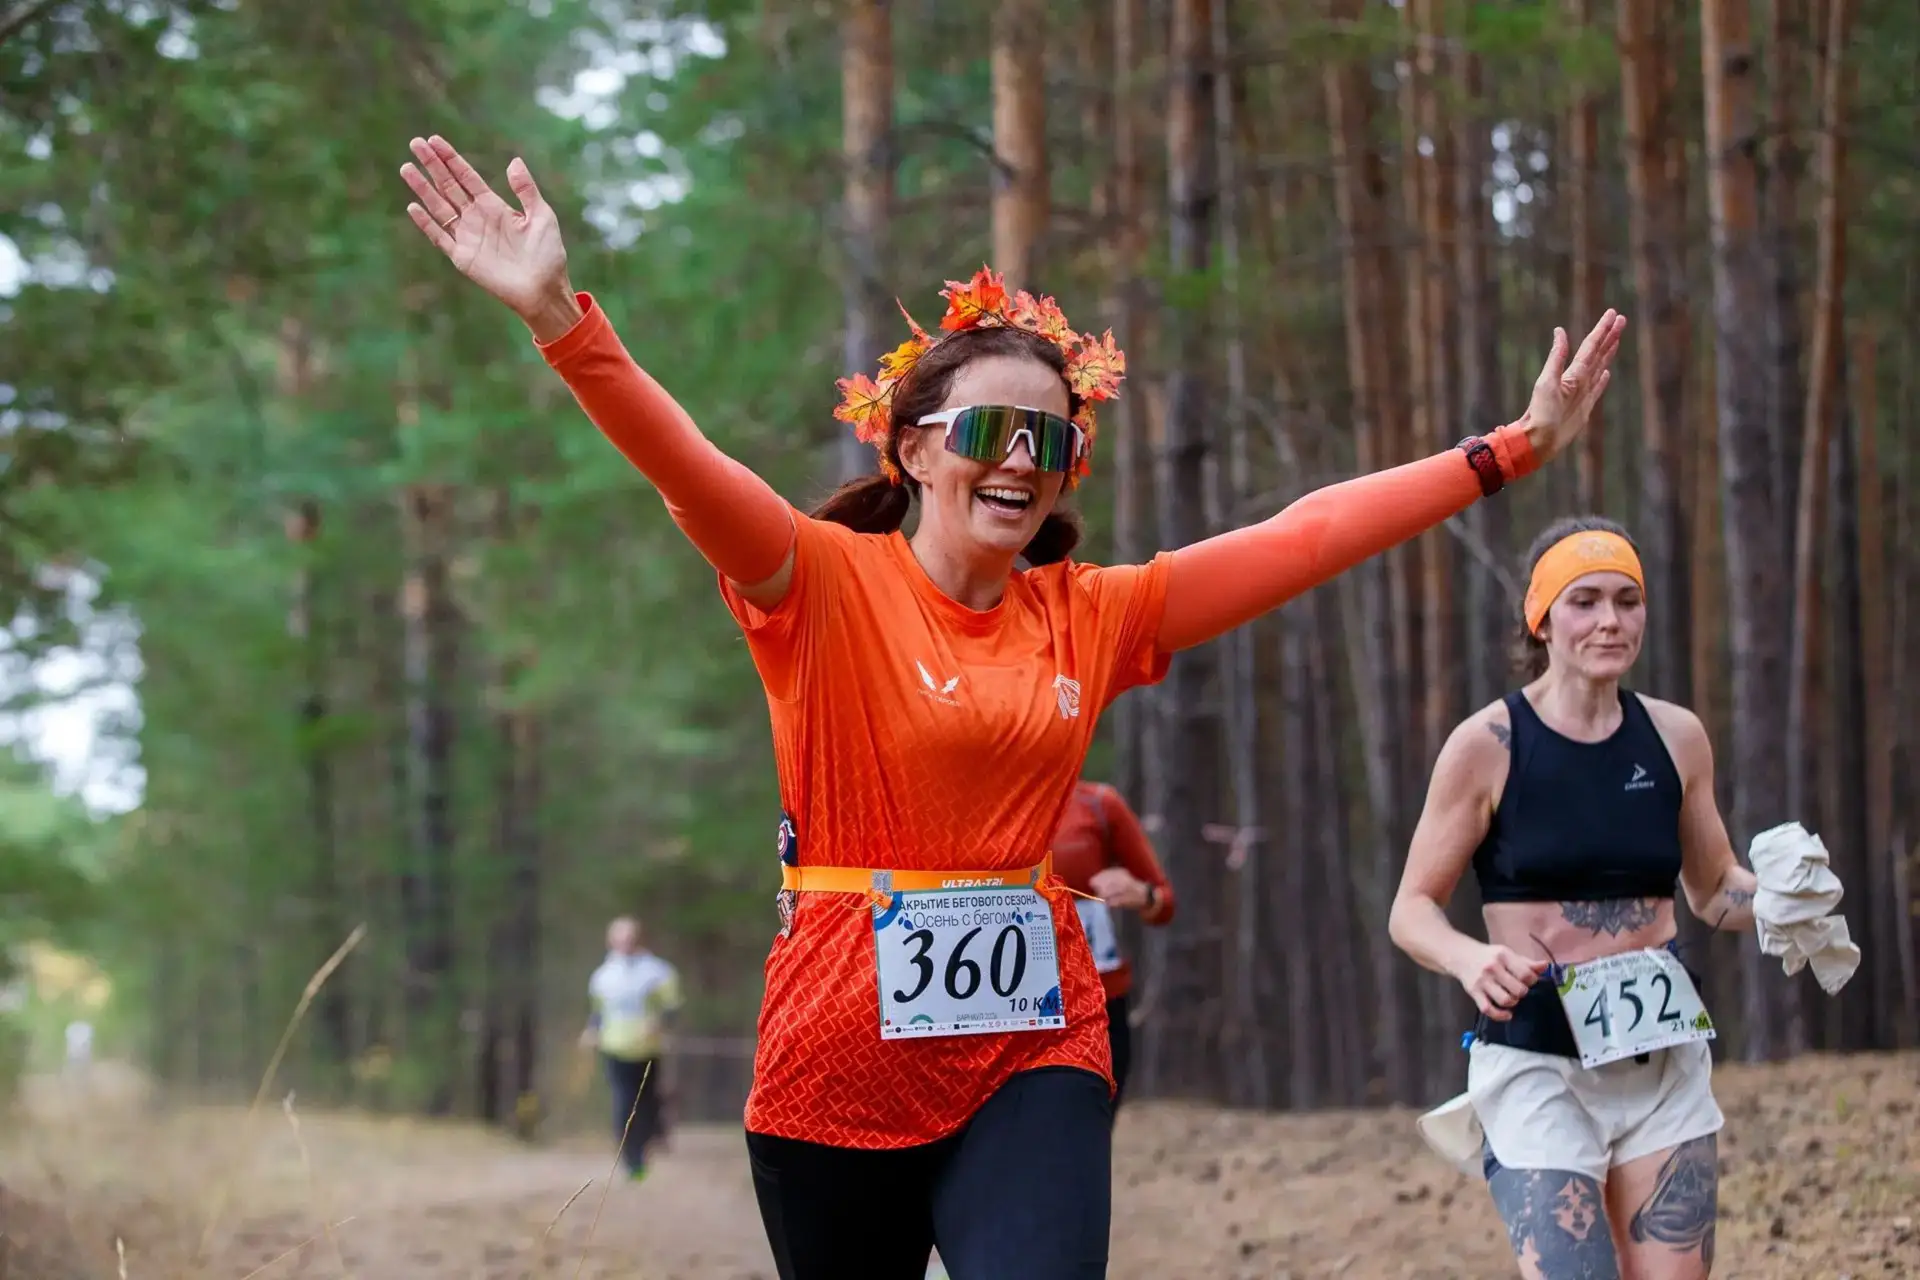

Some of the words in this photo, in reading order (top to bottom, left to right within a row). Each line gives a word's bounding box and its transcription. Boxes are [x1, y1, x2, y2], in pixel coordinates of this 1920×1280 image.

[942, 877, 1004, 889] ULTRA-TRI
[897, 898, 950, 911] АКРЫТИЕ
[952, 895, 1003, 909] БЕГОВОГО
[1004, 895, 1038, 907] СЕЗОНА
[913, 912, 959, 928] Осень
[962, 915, 971, 927] с
[974, 909, 1012, 926] бегом
[893, 924, 1027, 1004] 360
[1009, 997, 1028, 1012] 10
[1584, 972, 1681, 1038] 452
[1671, 1018, 1685, 1031] 21
